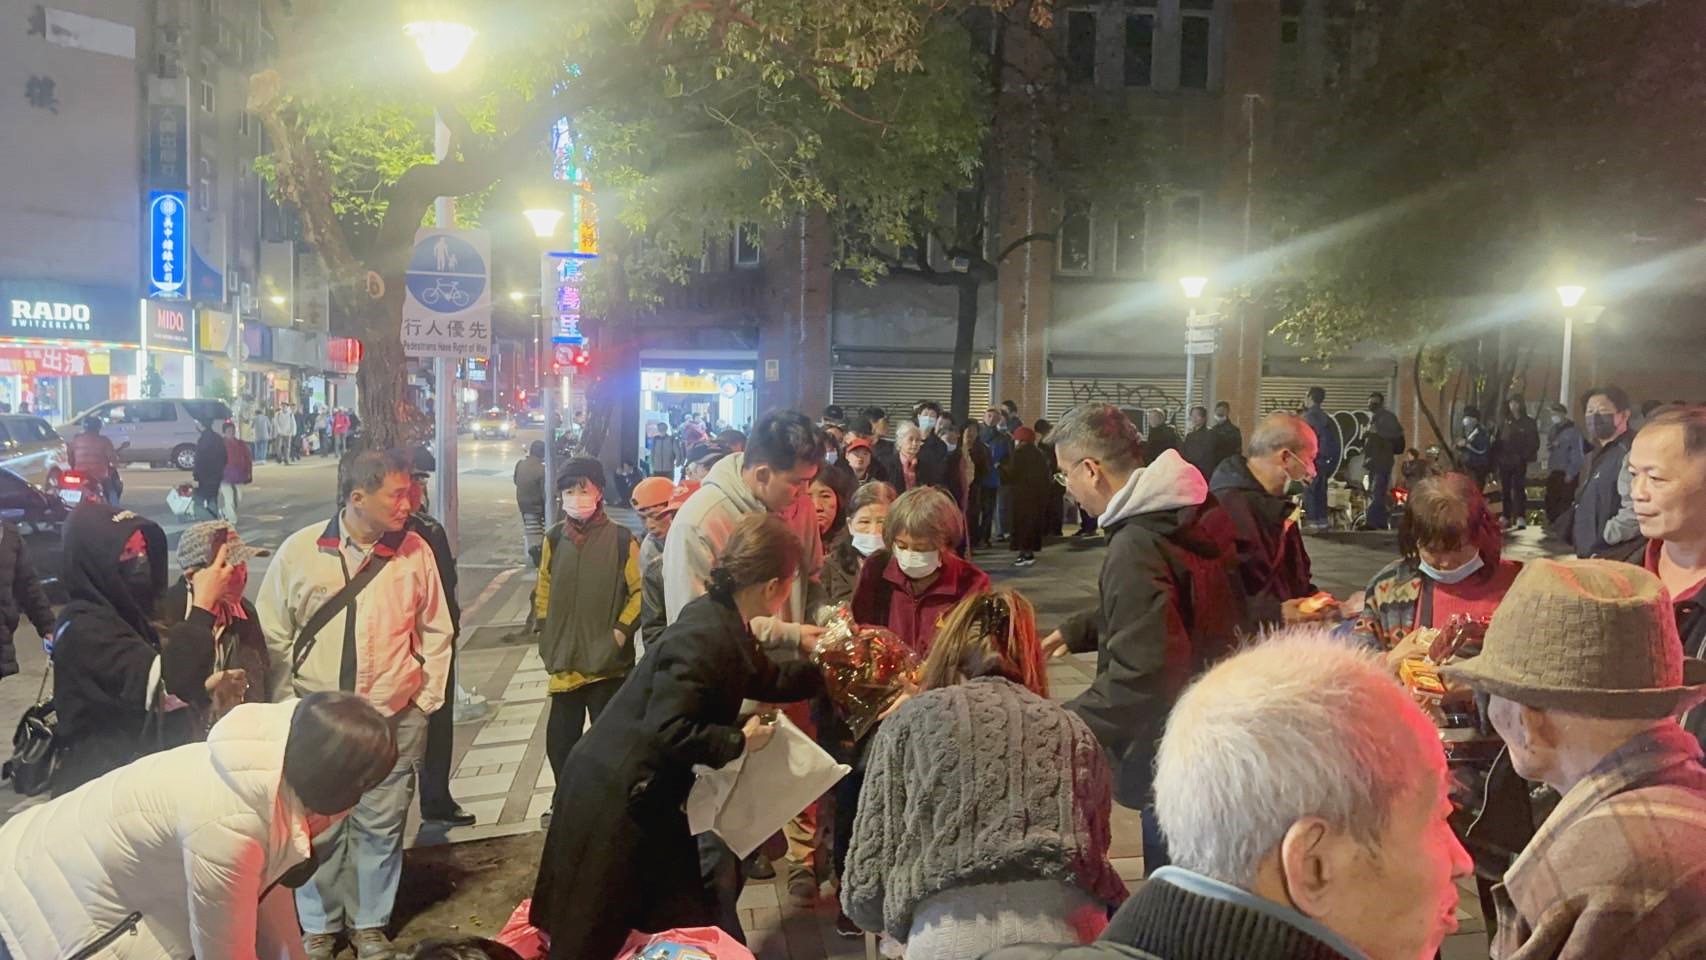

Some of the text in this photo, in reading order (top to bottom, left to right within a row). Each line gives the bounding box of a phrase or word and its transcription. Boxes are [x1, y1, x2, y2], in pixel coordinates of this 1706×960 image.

[11, 300, 90, 322] RADO
[157, 308, 184, 331] MIDO
[11, 318, 91, 331] SWITZERLAND
[404, 319, 488, 339] 行人優先
[453, 342, 468, 355] Right
